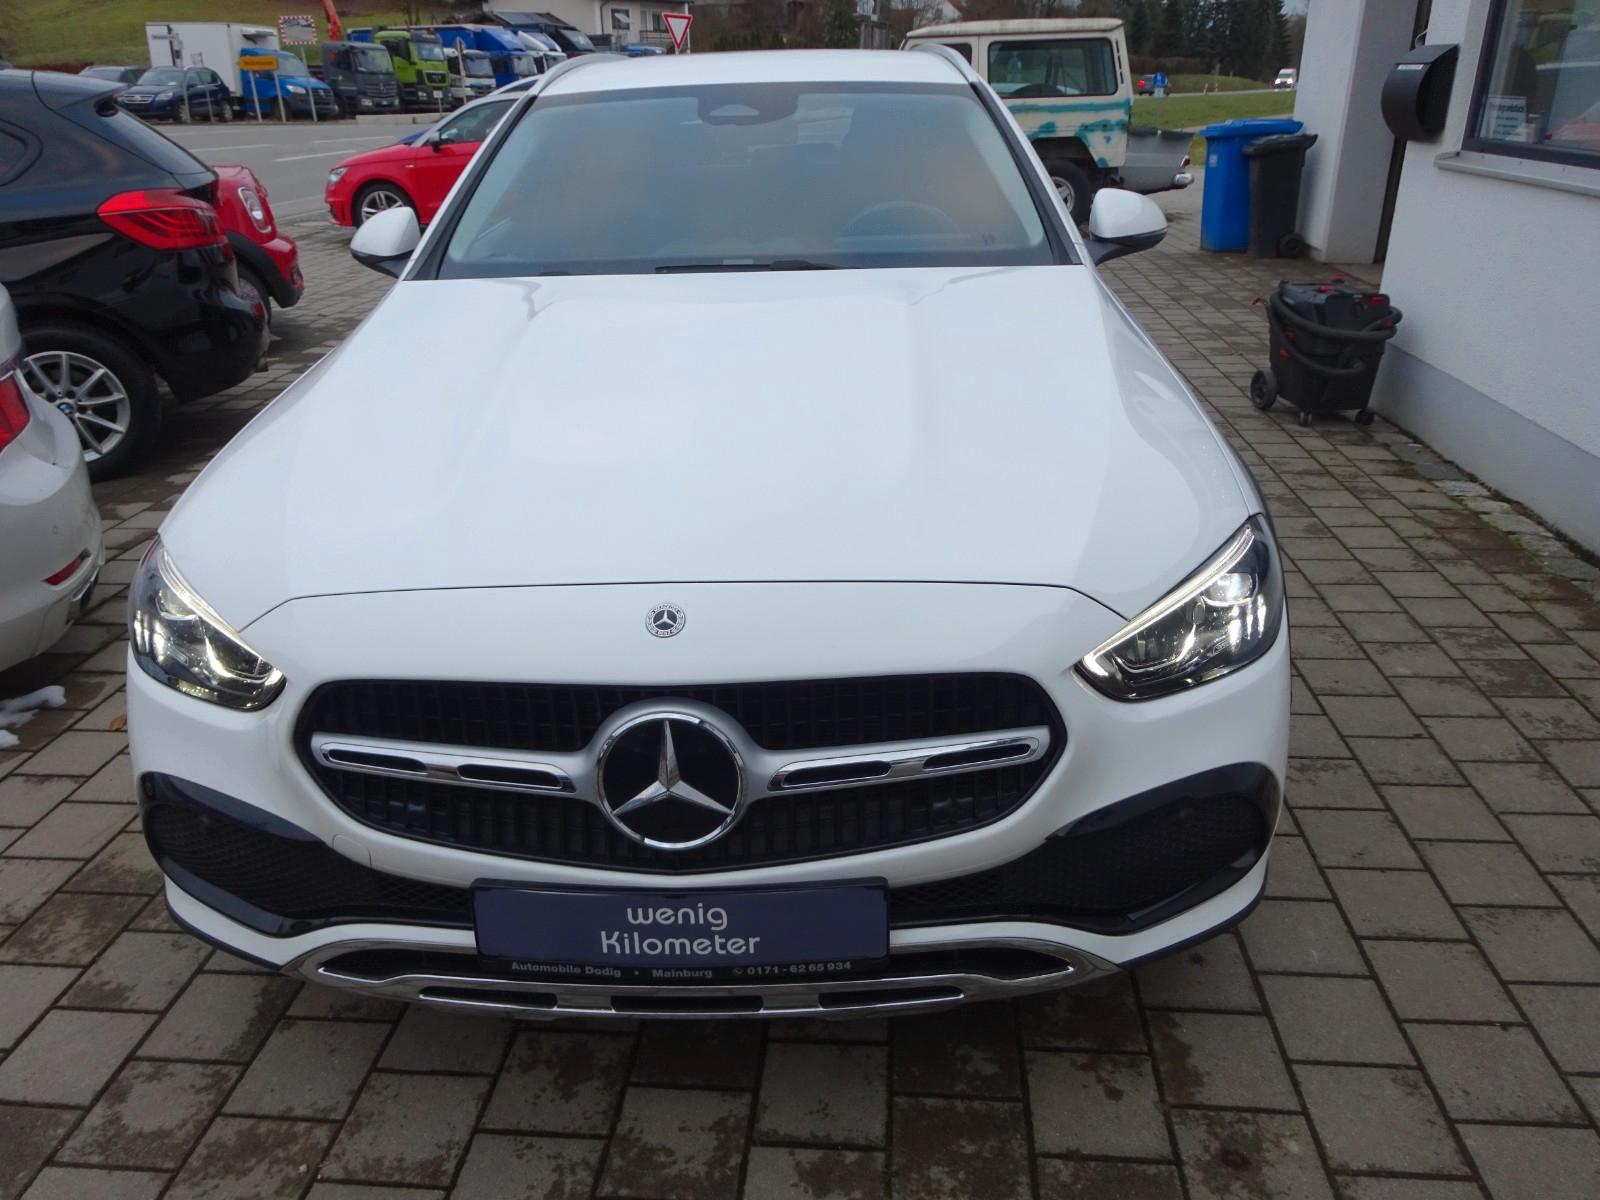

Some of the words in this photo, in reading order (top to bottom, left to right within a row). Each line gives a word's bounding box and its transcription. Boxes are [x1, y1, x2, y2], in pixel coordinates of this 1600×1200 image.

[626, 902, 728, 931] wenig
[600, 930, 761, 955] Kilometer
[511, 961, 582, 975] Automobile
[584, 965, 622, 978] Dodig
[652, 968, 712, 978] Mainburg
[747, 965, 779, 975] 0171
